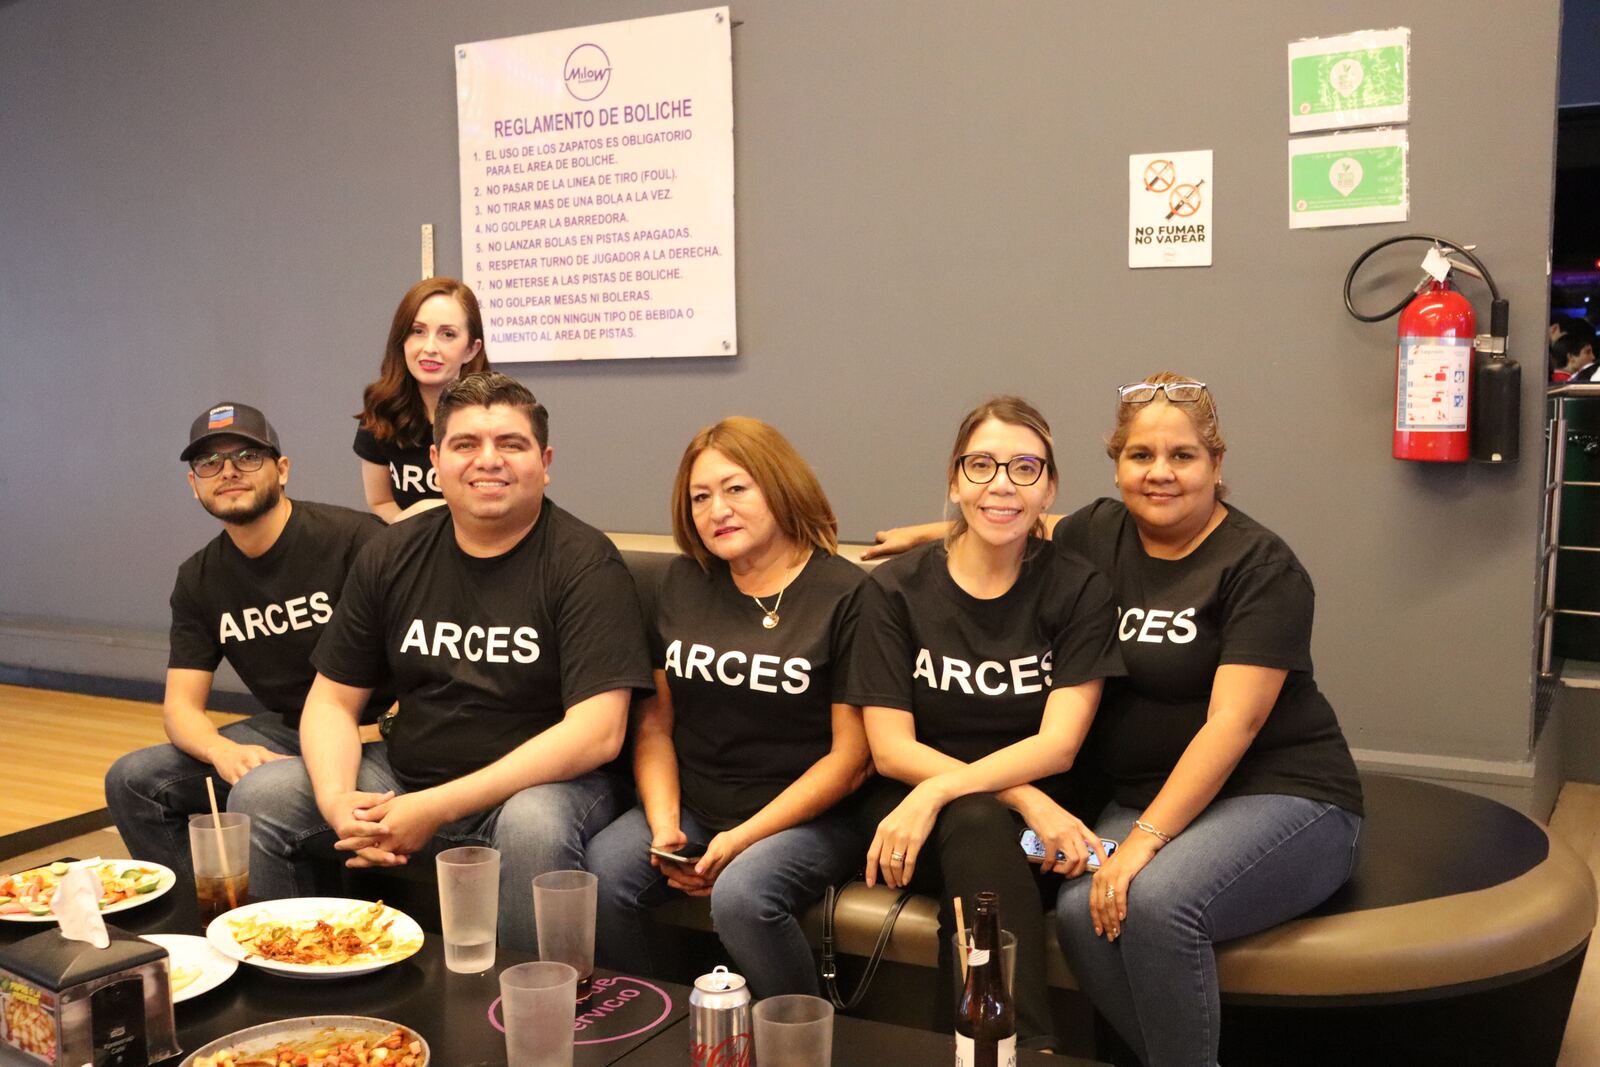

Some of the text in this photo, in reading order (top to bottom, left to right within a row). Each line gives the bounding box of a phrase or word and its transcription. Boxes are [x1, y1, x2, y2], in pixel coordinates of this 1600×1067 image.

[494, 99, 692, 138] REGLAMENTO DE BOLICHE
[473, 129, 692, 162] 1. EL USO DE LOS ZAPATOS ES OBLIGATORIO
[486, 154, 618, 176] PARA EL AREA DE BOLICHE.
[474, 169, 678, 197] 2. NO PASAR DE LA LINEA DE TIRO (FOUL).
[475, 189, 673, 216] 3. NO TIRAR MAS DE UNA BOLA A LA VEZ.
[475, 212, 629, 234] 4. NO GOLPEAR LA BARREDORA.
[1136, 224, 1205, 236] NO FUMAR
[476, 227, 692, 253] 5. NO LANZAR BOLAS EN PISTAS APAGADAS.
[1135, 234, 1206, 245] NO VAPEAR
[477, 245, 722, 272] 6. RESPETAR TURNO DE JUGADOR A LA DERECHA.
[489, 279, 503, 290] NO
[505, 276, 549, 289] METERSE
[552, 276, 559, 286] A
[561, 274, 580, 286] LAS
[582, 272, 617, 284] PISTAS
[619, 271, 633, 282] DE
[635, 268, 683, 281] BOLICHE.
[490, 298, 503, 309] NO
[506, 295, 551, 308] GOLPEAR
[554, 294, 587, 305] MESAS
[590, 293, 600, 303] NI
[602, 290, 653, 303] BOLERAS.
[490, 308, 694, 327] NO PASAR CON NINGUN TIPO DE BEBIDA O
[491, 327, 636, 343] ALIMENTO AL AREA DE PISTAS.
[219, 591, 333, 644] ARCES
[1117, 606, 1197, 644] CES
[400, 619, 540, 664] ARCES
[665, 639, 811, 694] ARCES
[575, 988, 641, 1031] ervicio
